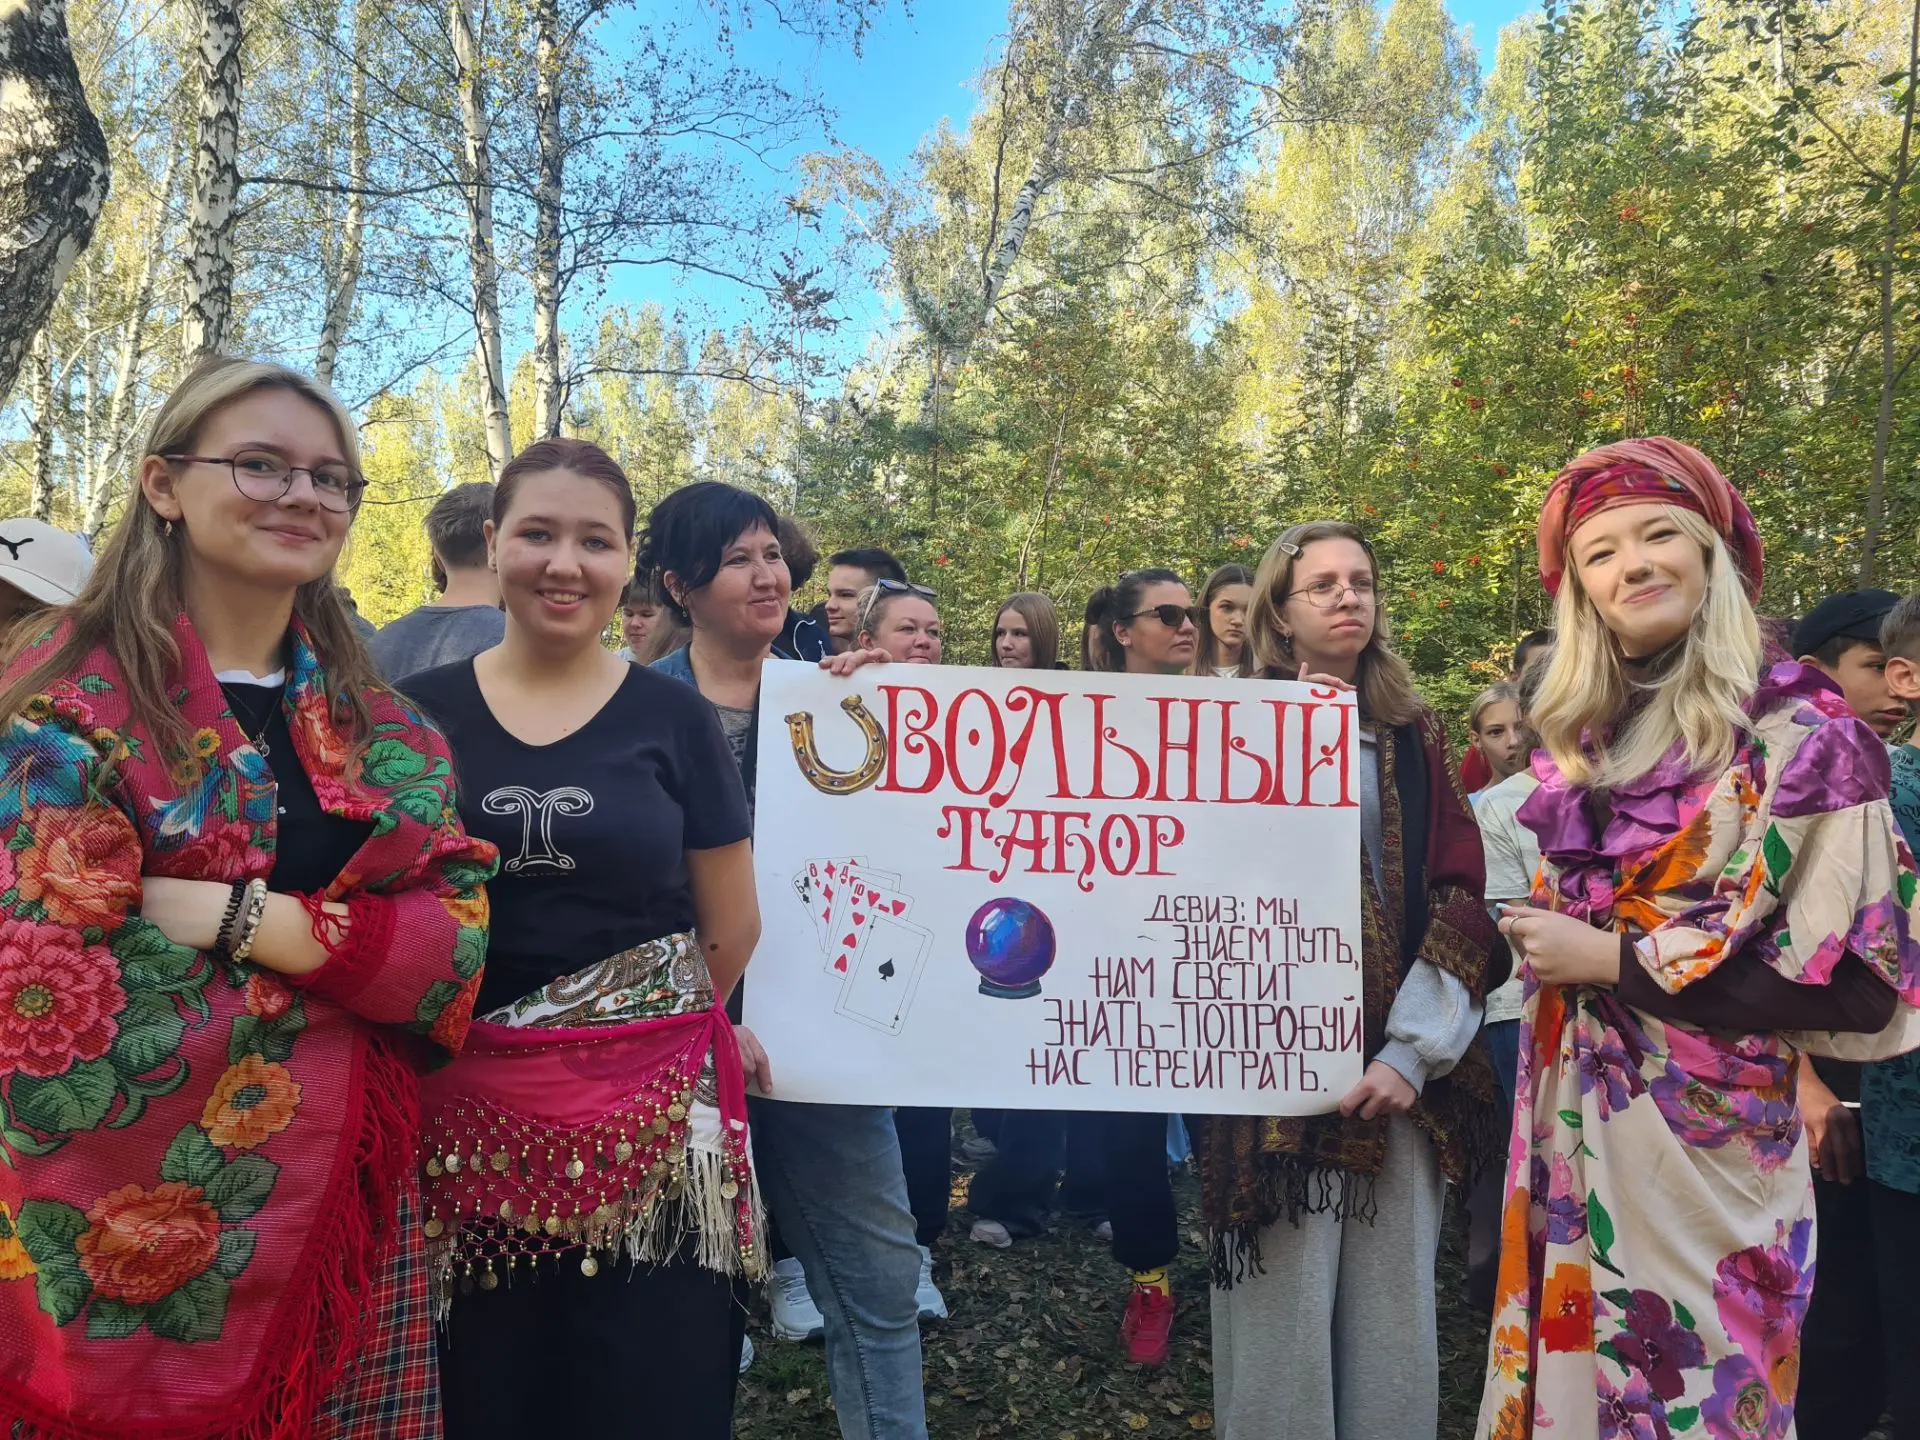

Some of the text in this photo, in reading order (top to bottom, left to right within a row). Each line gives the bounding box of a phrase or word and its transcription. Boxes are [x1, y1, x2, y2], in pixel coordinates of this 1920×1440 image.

[875, 685, 1360, 808] ВОЛЬНЫЙ
[809, 863, 818, 877] 8
[937, 805, 1185, 893] ТАБОР
[793, 879, 805, 894] 6
[854, 883, 865, 896] 10
[1144, 895, 1298, 925] ДЕВИЗ: МЫ
[1172, 924, 1359, 971] ЗНАЕМ ПУТЬ,
[1088, 957, 1299, 1001] НАМ СВЕТИТ
[1044, 996, 1362, 1053] ЗНАТЬ-ПОПРОБУЙ
[1025, 1048, 1328, 1093] НАС ПЕРЕИГРАТЬ.
